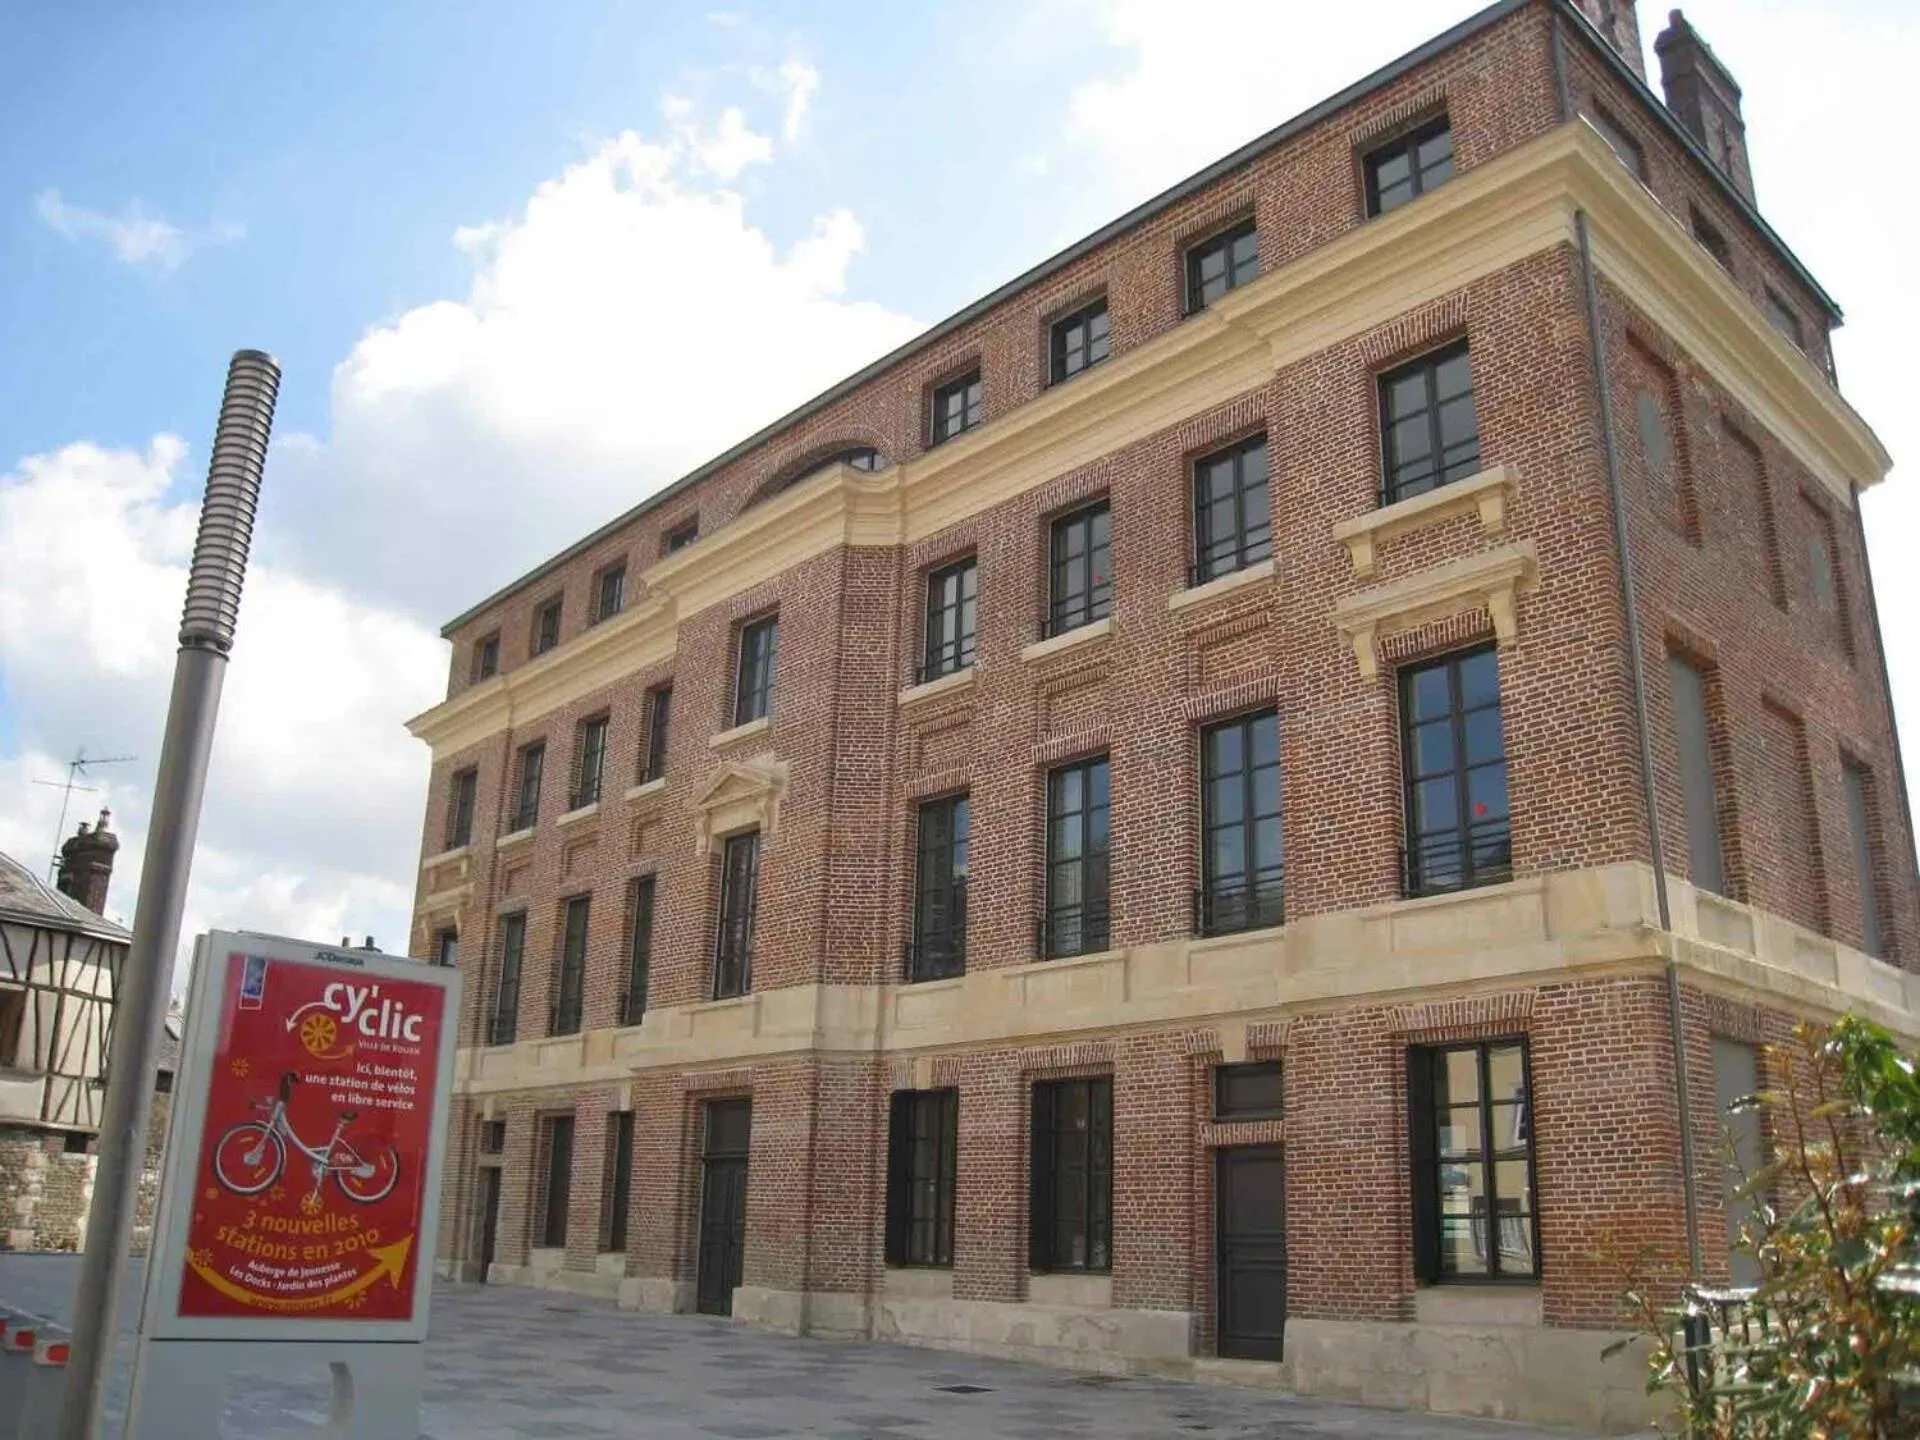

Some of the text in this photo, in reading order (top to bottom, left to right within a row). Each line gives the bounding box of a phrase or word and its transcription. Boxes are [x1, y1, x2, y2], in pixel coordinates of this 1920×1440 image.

[305, 1074, 328, 1085] une
[329, 1075, 369, 1090] station
[370, 1081, 385, 1092] de
[331, 1092, 415, 1110] en libre service
[243, 1210, 360, 1236] 3 nouvelles
[216, 1225, 379, 1260] stations en 2010
[287, 1267, 300, 1277] de
